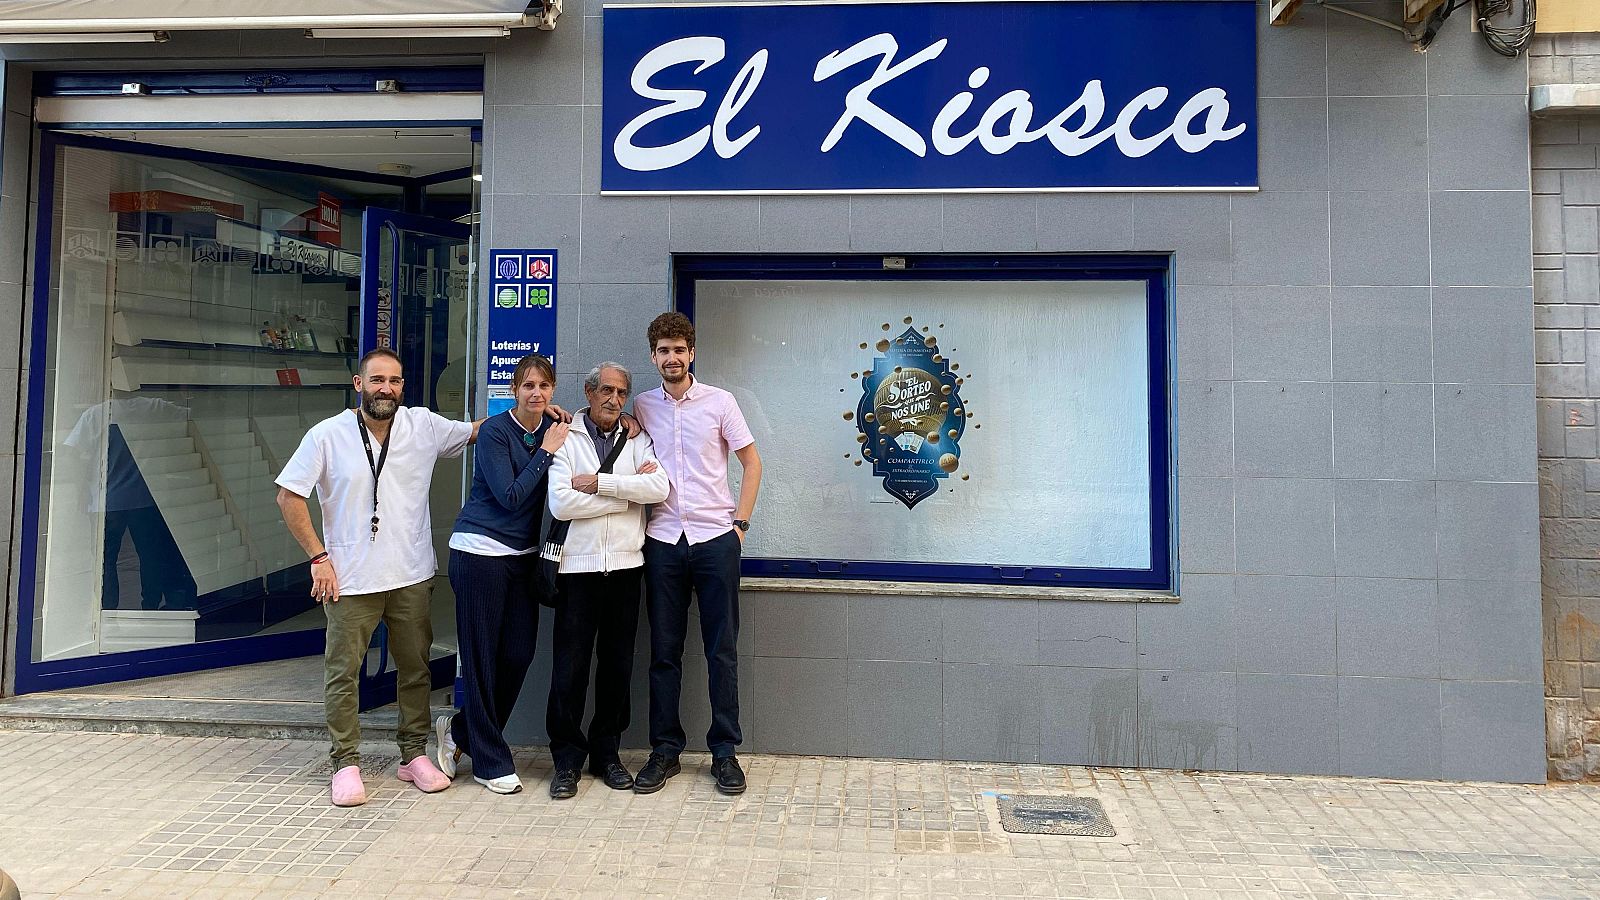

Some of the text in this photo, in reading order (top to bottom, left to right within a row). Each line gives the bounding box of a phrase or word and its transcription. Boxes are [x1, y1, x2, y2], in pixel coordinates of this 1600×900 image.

[614, 33, 1246, 171] El Kiosco
[492, 340, 540, 353] Loterías y
[491, 371, 515, 380] Esta
[906, 378, 918, 387] EL
[887, 380, 932, 403] SORTEO
[891, 399, 931, 420] NOS UNE
[887, 457, 935, 465] COMPARTIRLO
